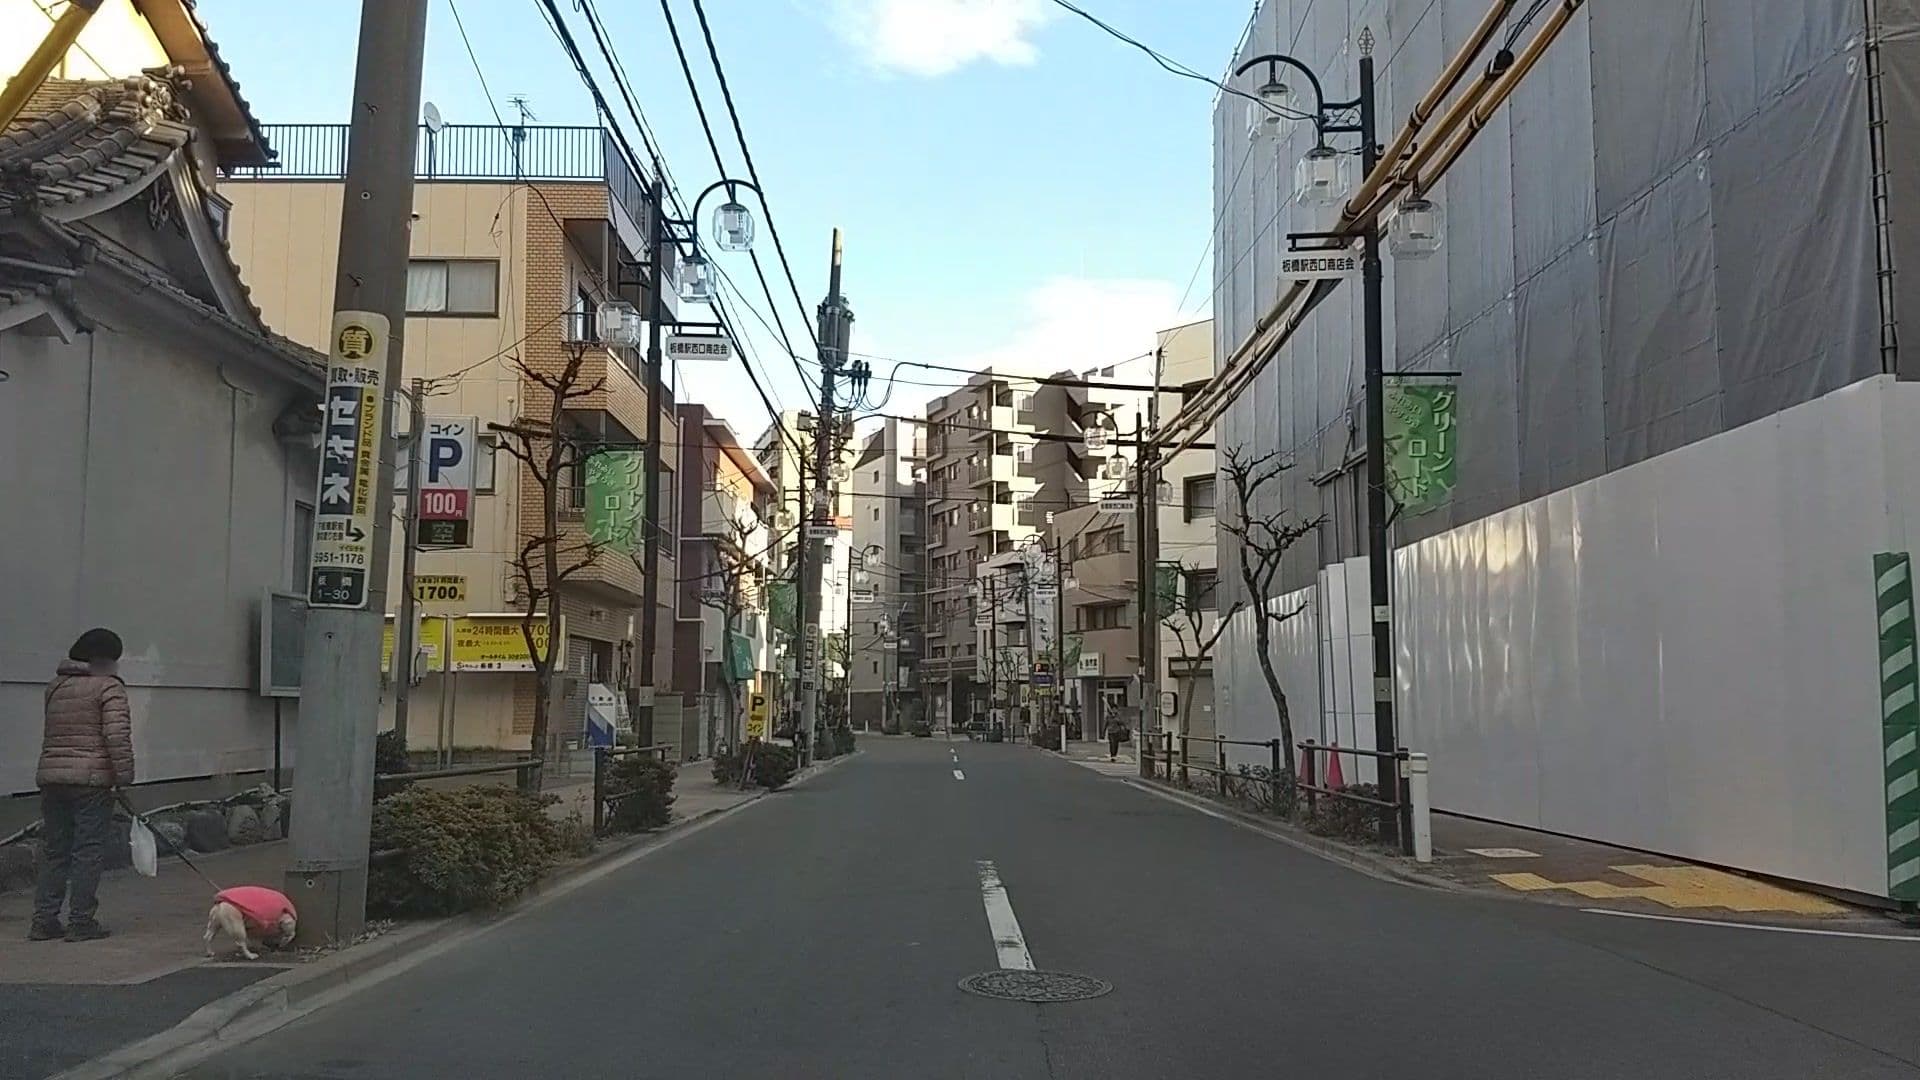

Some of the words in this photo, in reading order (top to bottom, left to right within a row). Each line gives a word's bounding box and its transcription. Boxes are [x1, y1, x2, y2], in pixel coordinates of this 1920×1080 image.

[341, 328, 371, 358] 質
[430, 423, 464, 436] コイン
[1432, 391, 1455, 472] グリーン
[322, 395, 359, 504] セキネ
[428, 438, 463, 483] P
[1408, 439, 1428, 497] ロード
[314, 552, 364, 565] 5951-1178
[318, 590, 350, 600] 1-30
[752, 695, 765, 711] P
